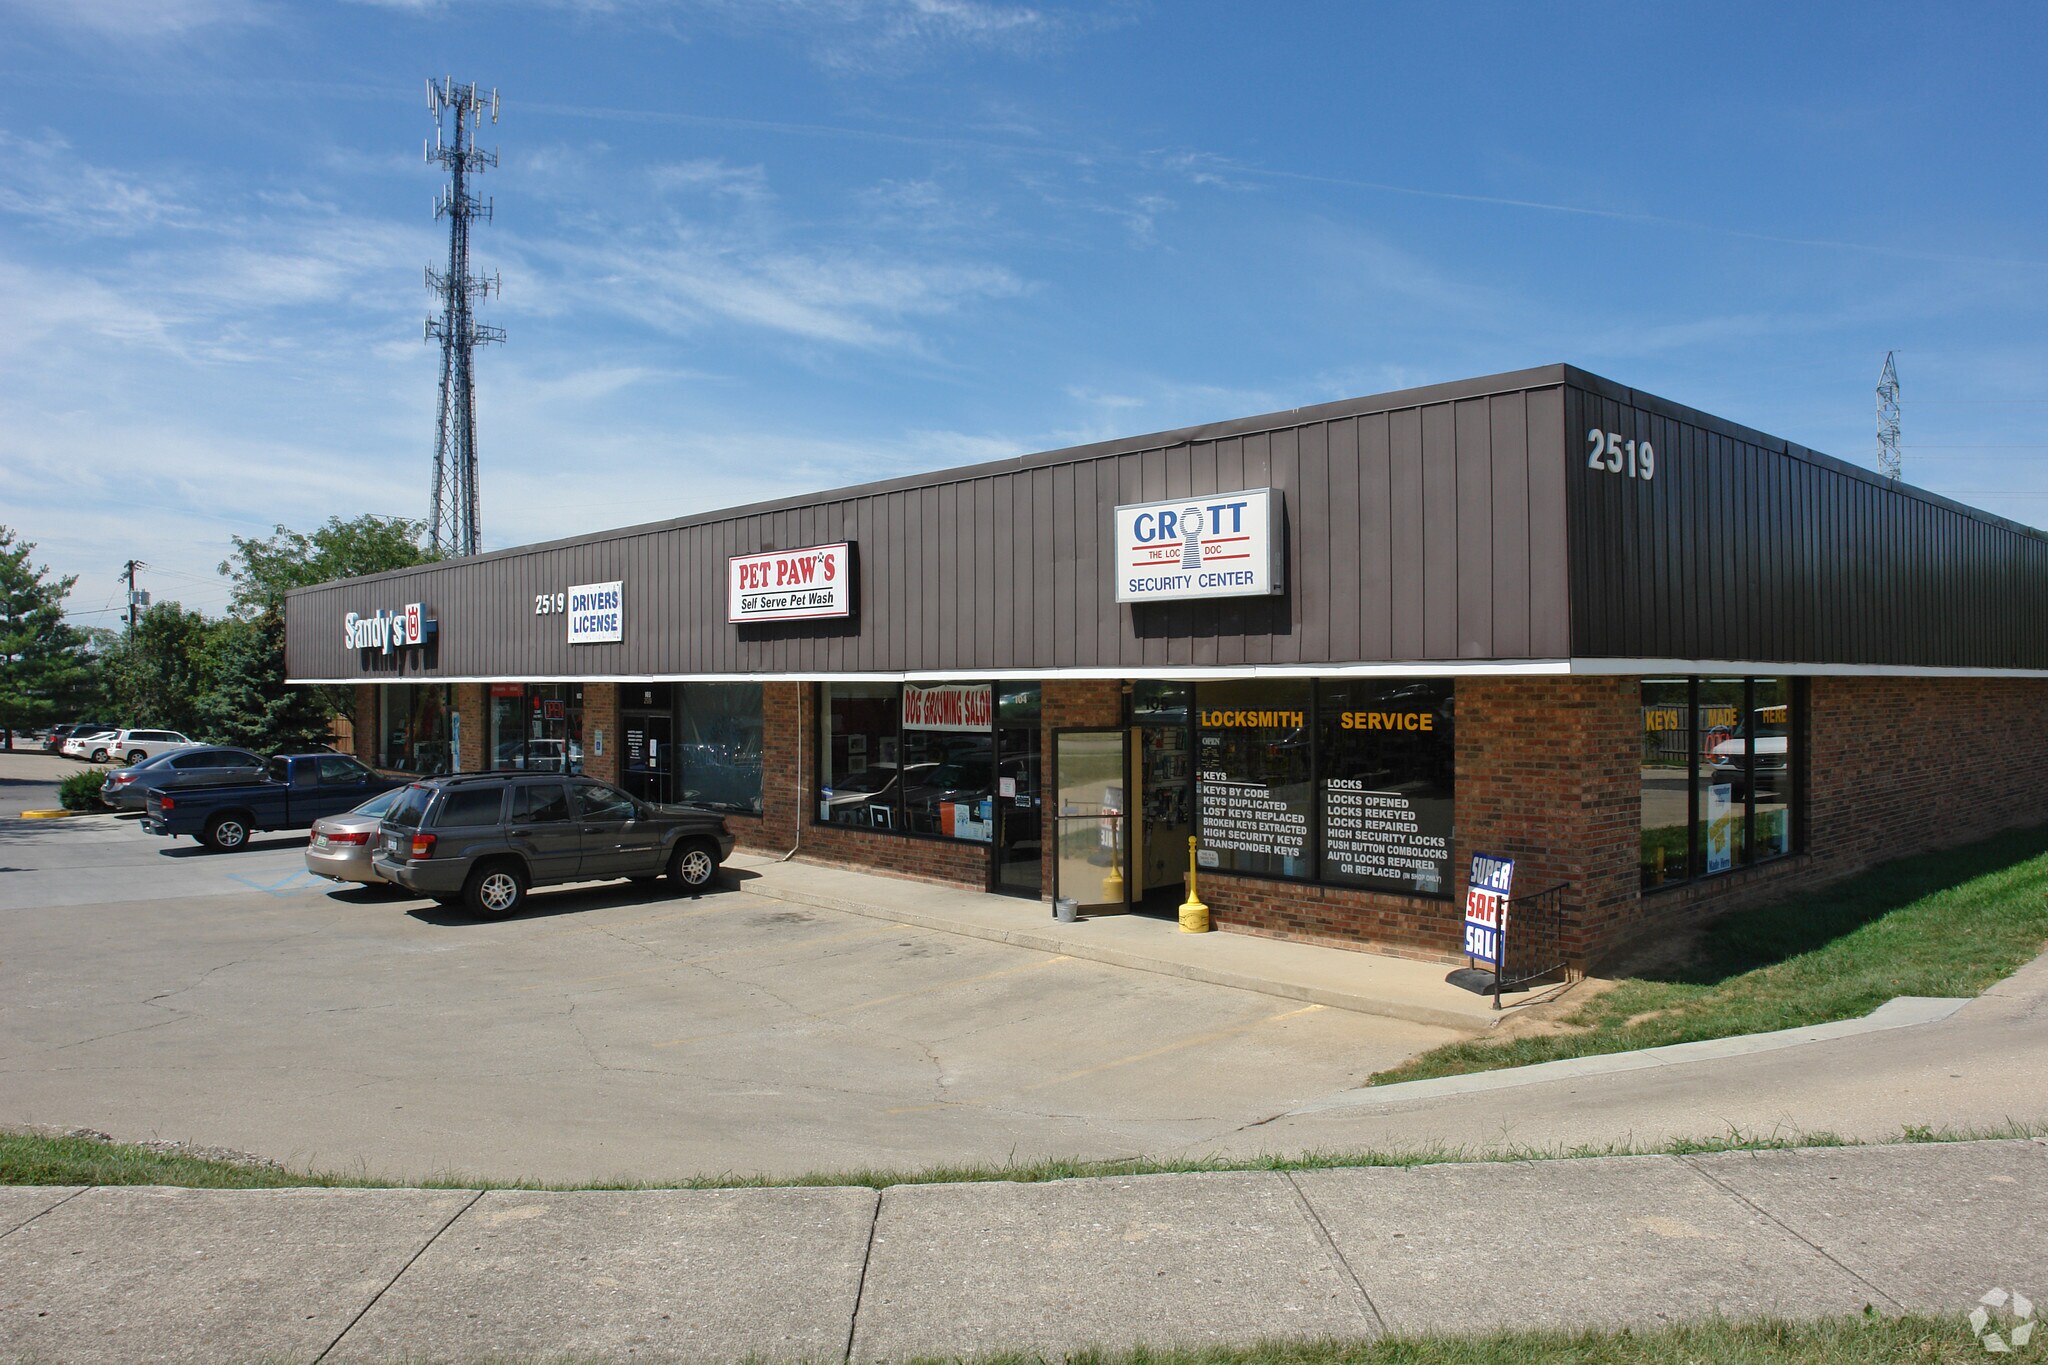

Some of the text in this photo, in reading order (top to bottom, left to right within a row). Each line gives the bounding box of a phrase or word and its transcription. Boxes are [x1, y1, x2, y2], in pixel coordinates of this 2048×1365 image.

[1587, 428, 1655, 480] 2519
[1133, 502, 1248, 543] GROTT
[1149, 545, 1222, 559] THE LOC DOC
[739, 552, 836, 590] PET PAW'S
[1129, 571, 1254, 593] SECURITY CENTER
[535, 593, 565, 615] 2519
[572, 591, 618, 612] DRIVERS
[741, 591, 834, 610] Self Serve Pet Wash
[345, 609, 406, 655] Sandy's
[573, 613, 618, 633] LICENSE
[905, 690, 992, 726] DOG GROOMING SALON
[1015, 695, 1028, 705] 104
[1201, 711, 1433, 731] LOCKSMITH SERVICE
[1645, 707, 1788, 731] KEYS MADE HERE
[1202, 737, 1220, 746] OPEN
[1203, 771, 1227, 781] KEYS
[1327, 779, 1362, 789] LOCKS
[1203, 786, 1270, 799] KEYS BY CODE
[1327, 794, 1409, 808] LOCKS OPENED
[1203, 796, 1287, 811] KEYS DUPLICATED
[1203, 807, 1305, 823] LOST KEYS REPLACED
[1327, 806, 1416, 821] LOCKS REKEYED
[1203, 817, 1307, 835] BROKEN KEYS EXTRACTED
[1327, 817, 1418, 833] LOCKS REPAIRED
[1203, 828, 1303, 846] HIGH SECURITY KEYS
[1327, 828, 1445, 847] HIGH SECURITY LOCKS
[1203, 838, 1300, 857] TRANSPONDER KEYS
[1327, 840, 1448, 860] PUSH BUTTON COMBOLOCKS
[1327, 851, 1435, 870] AUTO LOCKS REPAIRED
[1341, 863, 1353, 874] OR
[1355, 865, 1401, 879] REPLACED
[1411, 873, 1425, 881] SHOP
[1470, 856, 1511, 890] SUPER
